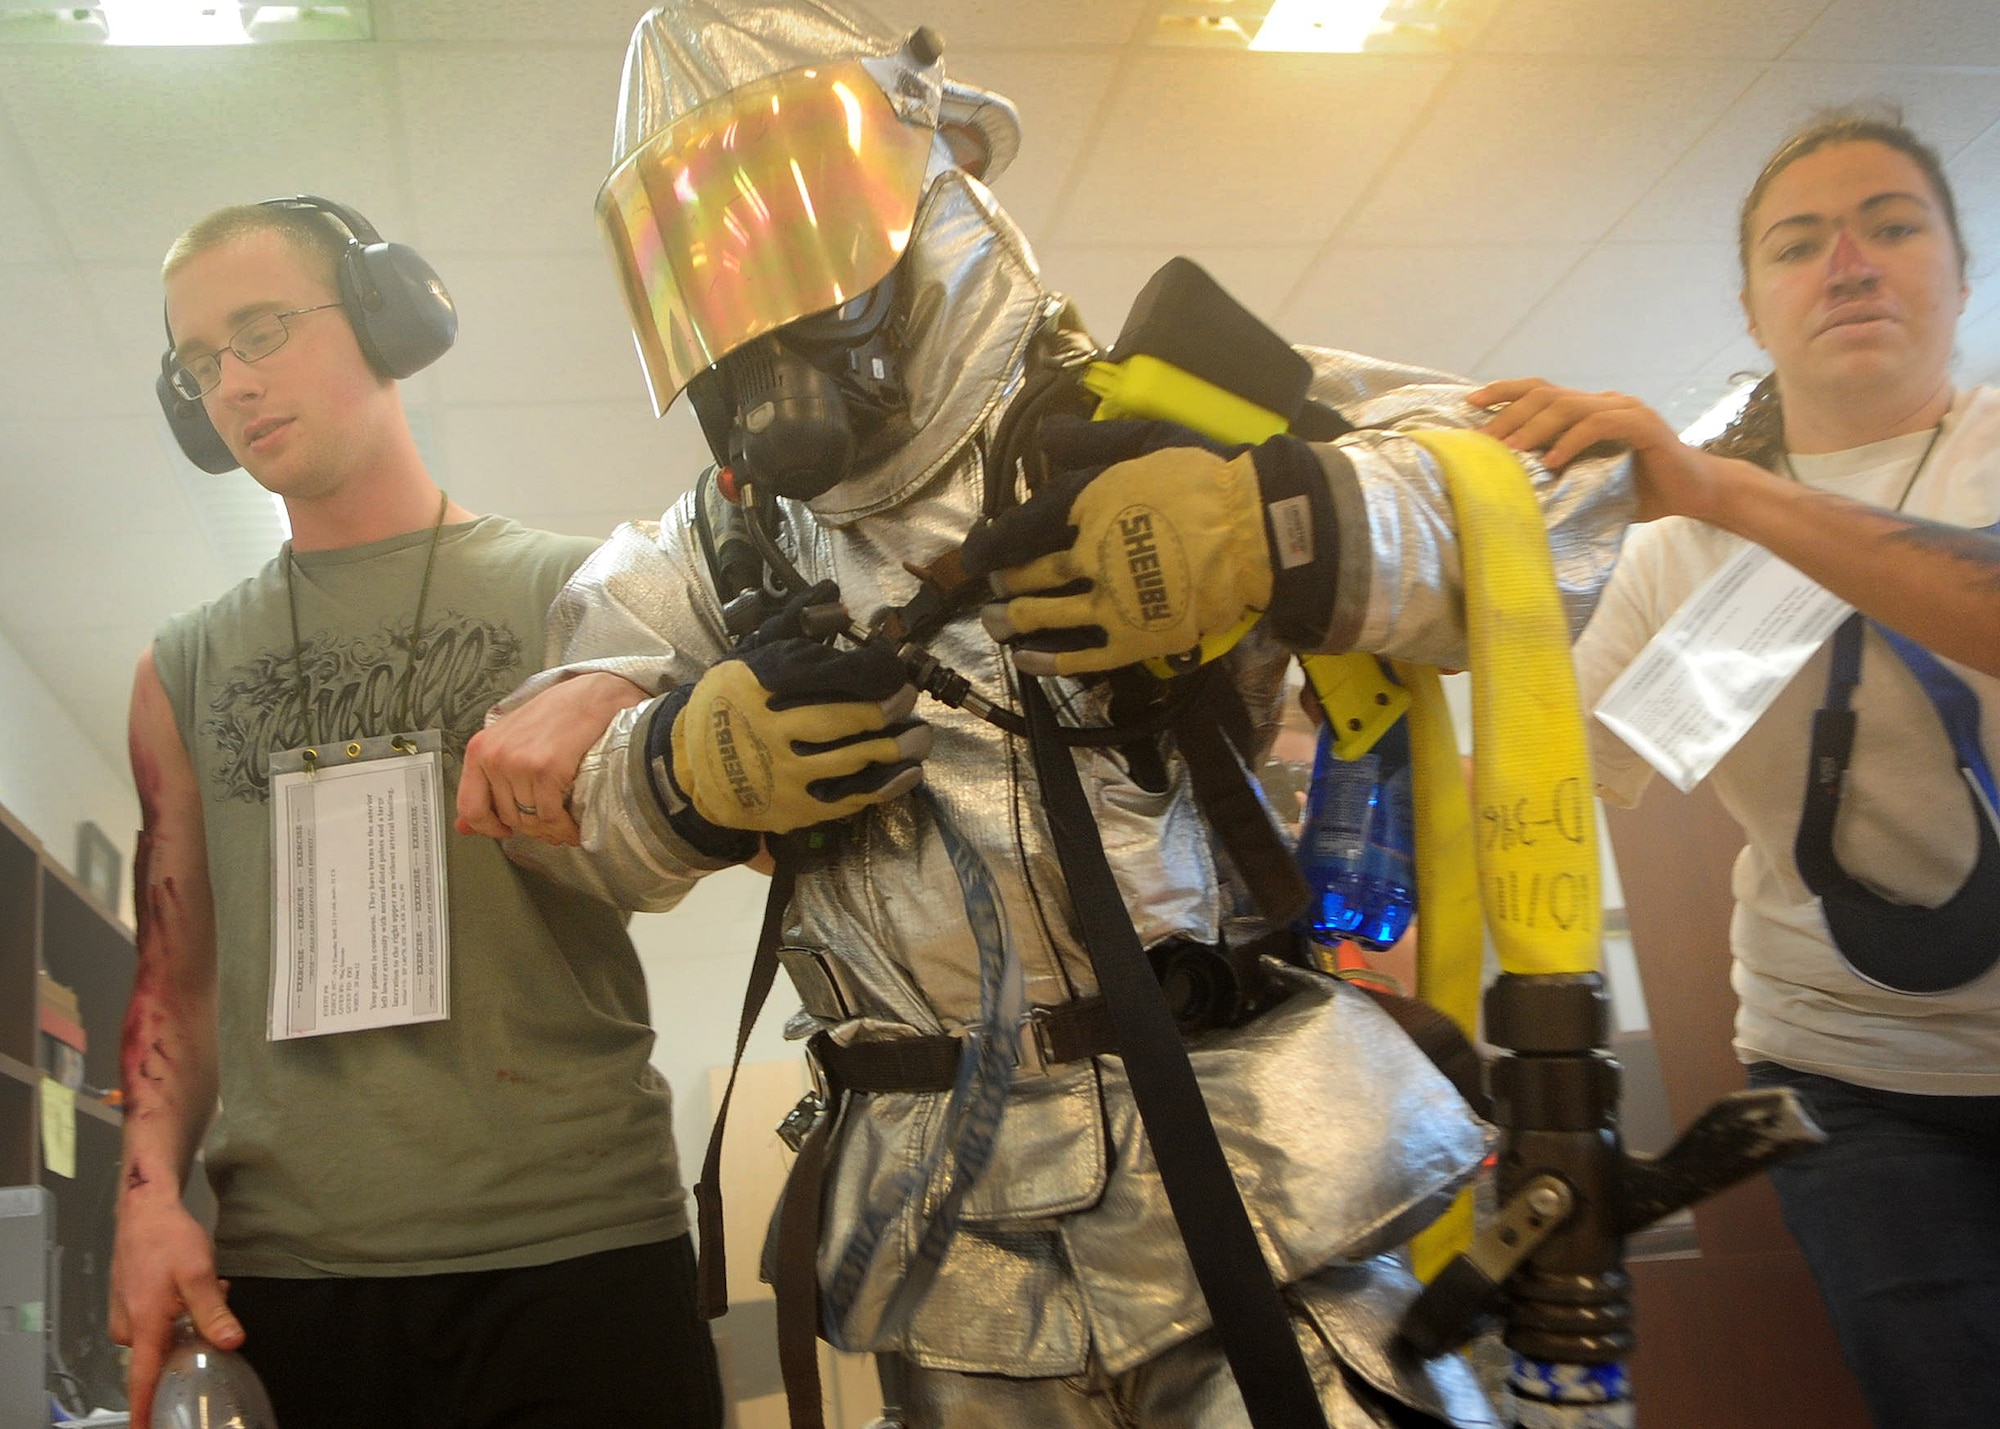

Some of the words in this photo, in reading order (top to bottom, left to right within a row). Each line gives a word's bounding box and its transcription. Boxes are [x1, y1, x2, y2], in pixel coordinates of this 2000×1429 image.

[1118, 513, 1173, 621] SHELBY
[713, 709, 764, 808] SHELBY
[387, 822, 395, 850] arterial
[411, 806, 419, 850] EXERCISE
[296, 825, 304, 868] EXERCISE
[378, 840, 387, 863] pulses
[378, 864, 386, 885] distal
[369, 892, 377, 911] They
[378, 886, 386, 914] normal
[413, 868, 422, 912] EXERCISE
[391, 900, 399, 923] upper
[391, 925, 400, 944] right
[381, 935, 389, 972] extremity
[416, 931, 424, 976] EXERCISE
[296, 950, 304, 992] EXERCISE
[370, 963, 379, 990] patient
[369, 991, 377, 1010] Your
[380, 995, 388, 1009] left
[391, 969, 399, 1007] laceration
